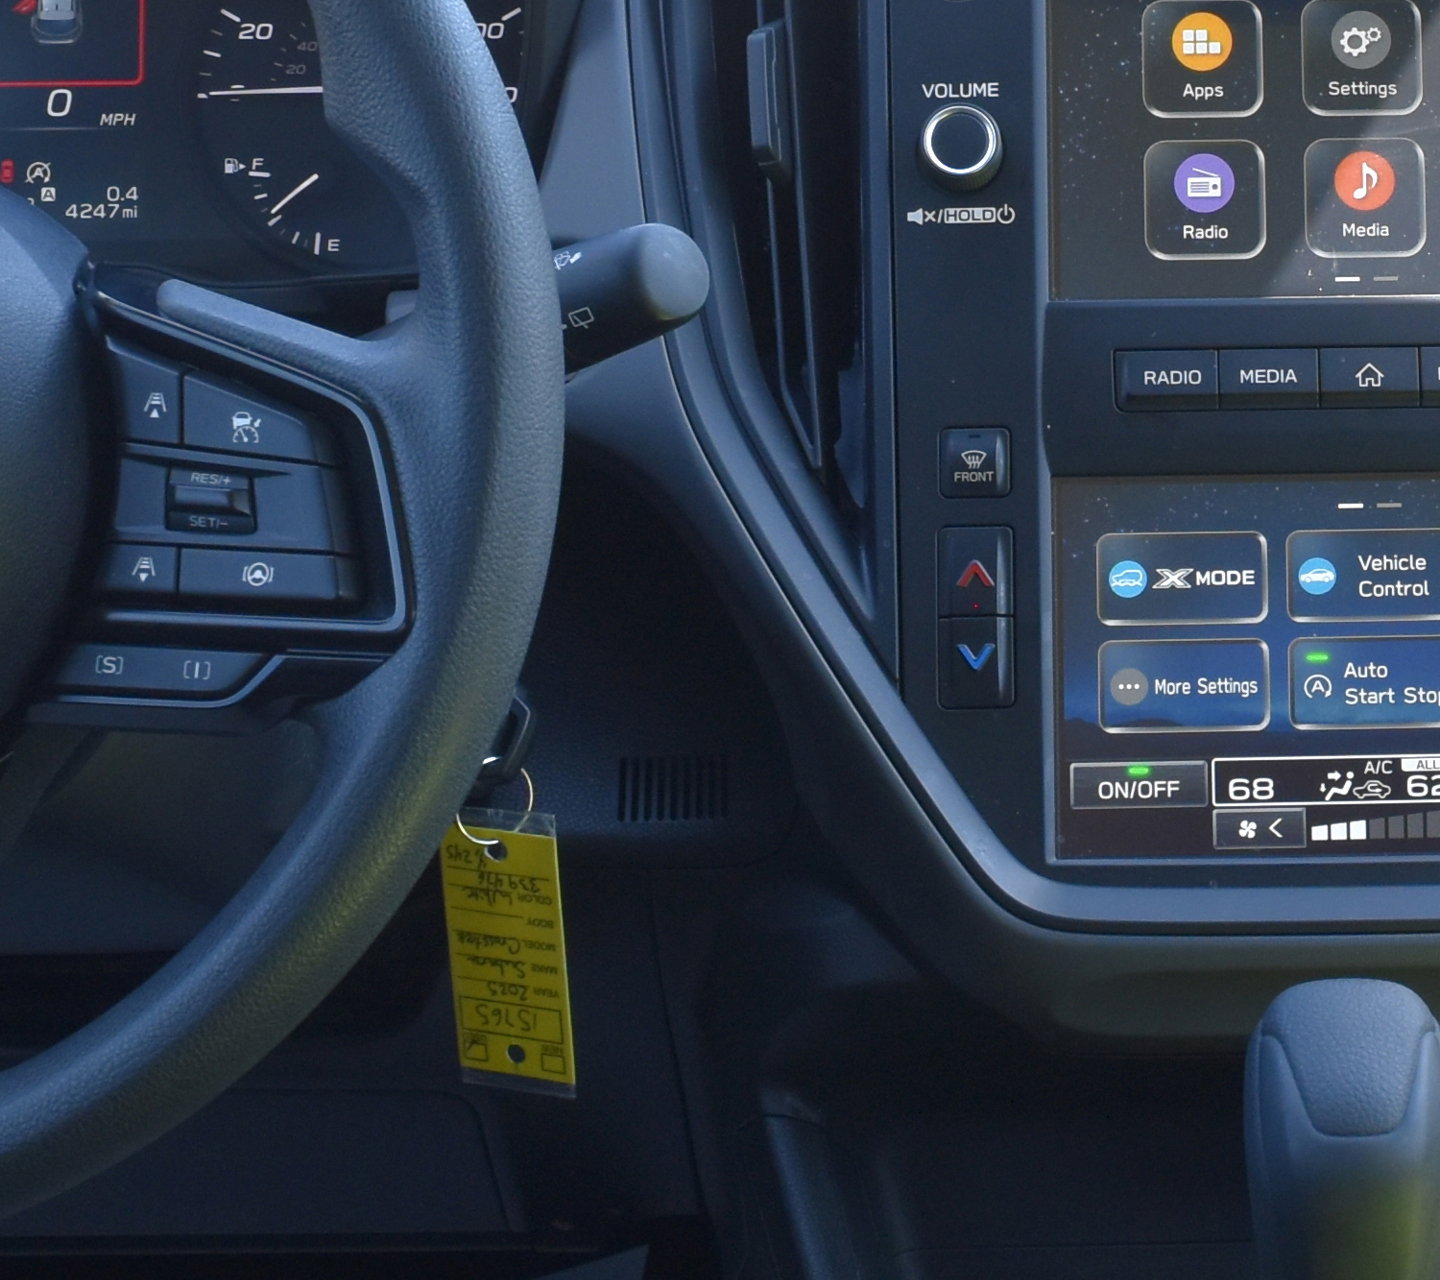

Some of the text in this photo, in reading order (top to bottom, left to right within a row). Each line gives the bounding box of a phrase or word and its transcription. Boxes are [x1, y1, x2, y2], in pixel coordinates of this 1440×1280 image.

[238, 23, 273, 40] 20
[297, 41, 318, 52] 40
[286, 64, 306, 75] 20
[922, 82, 1000, 98] VOLUME
[1183, 83, 1224, 100] Apps
[1328, 80, 1398, 97] Settings
[46, 88, 72, 117] 0
[100, 113, 136, 126] MPH
[251, 158, 264, 170] F
[106, 186, 139, 202] 0.4
[65, 204, 138, 219] 4247 mi
[945, 209, 995, 222] HOLD
[1182, 224, 1229, 240] Radio
[1342, 222, 1390, 238] Media
[327, 239, 340, 252] E
[1143, 370, 1202, 386] RADIO
[1240, 368, 1298, 384] MEDIA
[954, 471, 994, 482] FRONT
[1357, 554, 1427, 571] Vehicle
[1358, 580, 1430, 597] Control
[1344, 661, 1389, 678] Auto
[1154, 676, 1259, 698] More Settings
[1345, 687, 1394, 704] Start
[1363, 759, 1393, 776] A/C
[1098, 780, 1180, 800] ON/OFF
[1227, 777, 1275, 801] 68
[516, 893, 553, 906] COLOR
[527, 918, 555, 929] BODY
[521, 939, 556, 952] MODEL
[486, 980, 560, 1001] YEAR 2025
[475, 1004, 538, 1032] 15765
